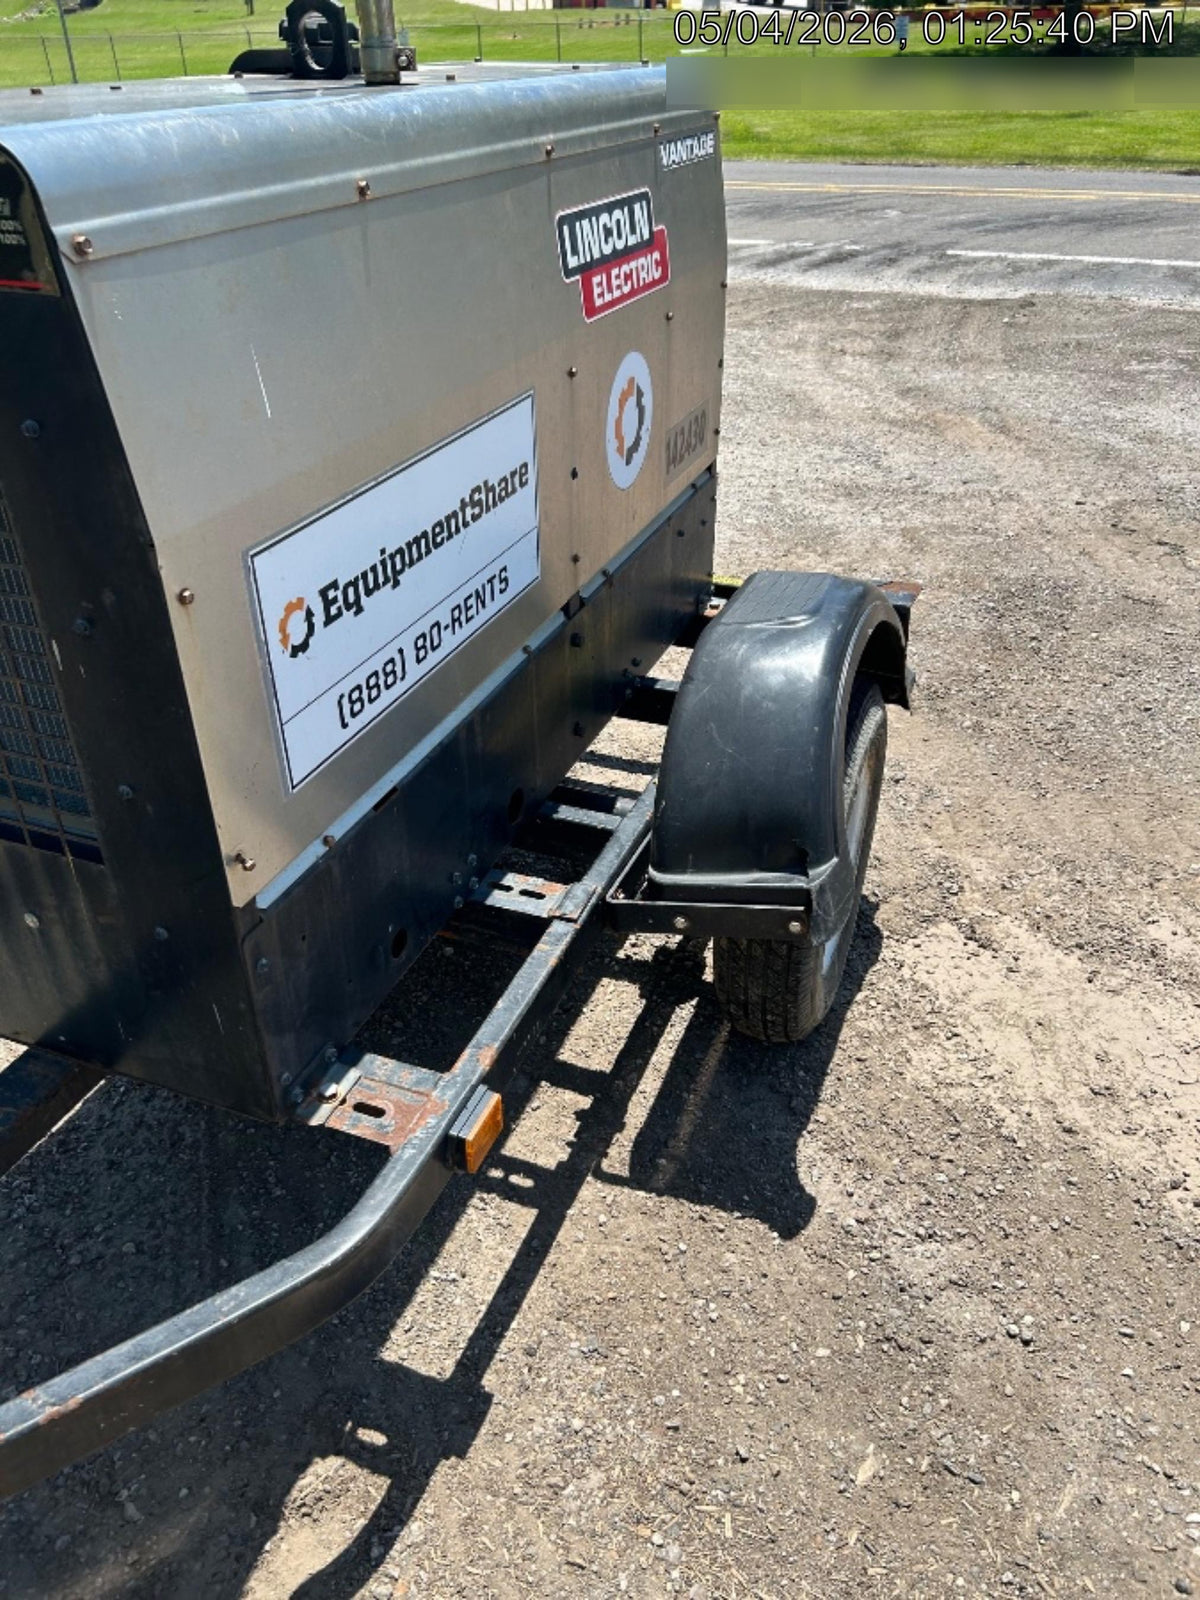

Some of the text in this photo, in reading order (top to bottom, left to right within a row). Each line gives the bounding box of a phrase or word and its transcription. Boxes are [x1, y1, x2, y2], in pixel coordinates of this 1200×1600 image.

[660, 132, 716, 168] VANTAGE
[563, 200, 650, 270] LINCOLN
[591, 250, 663, 308] ELECTRIC
[318, 460, 529, 629] EquipmentShare
[337, 565, 511, 730] (888) 80-RENTS
